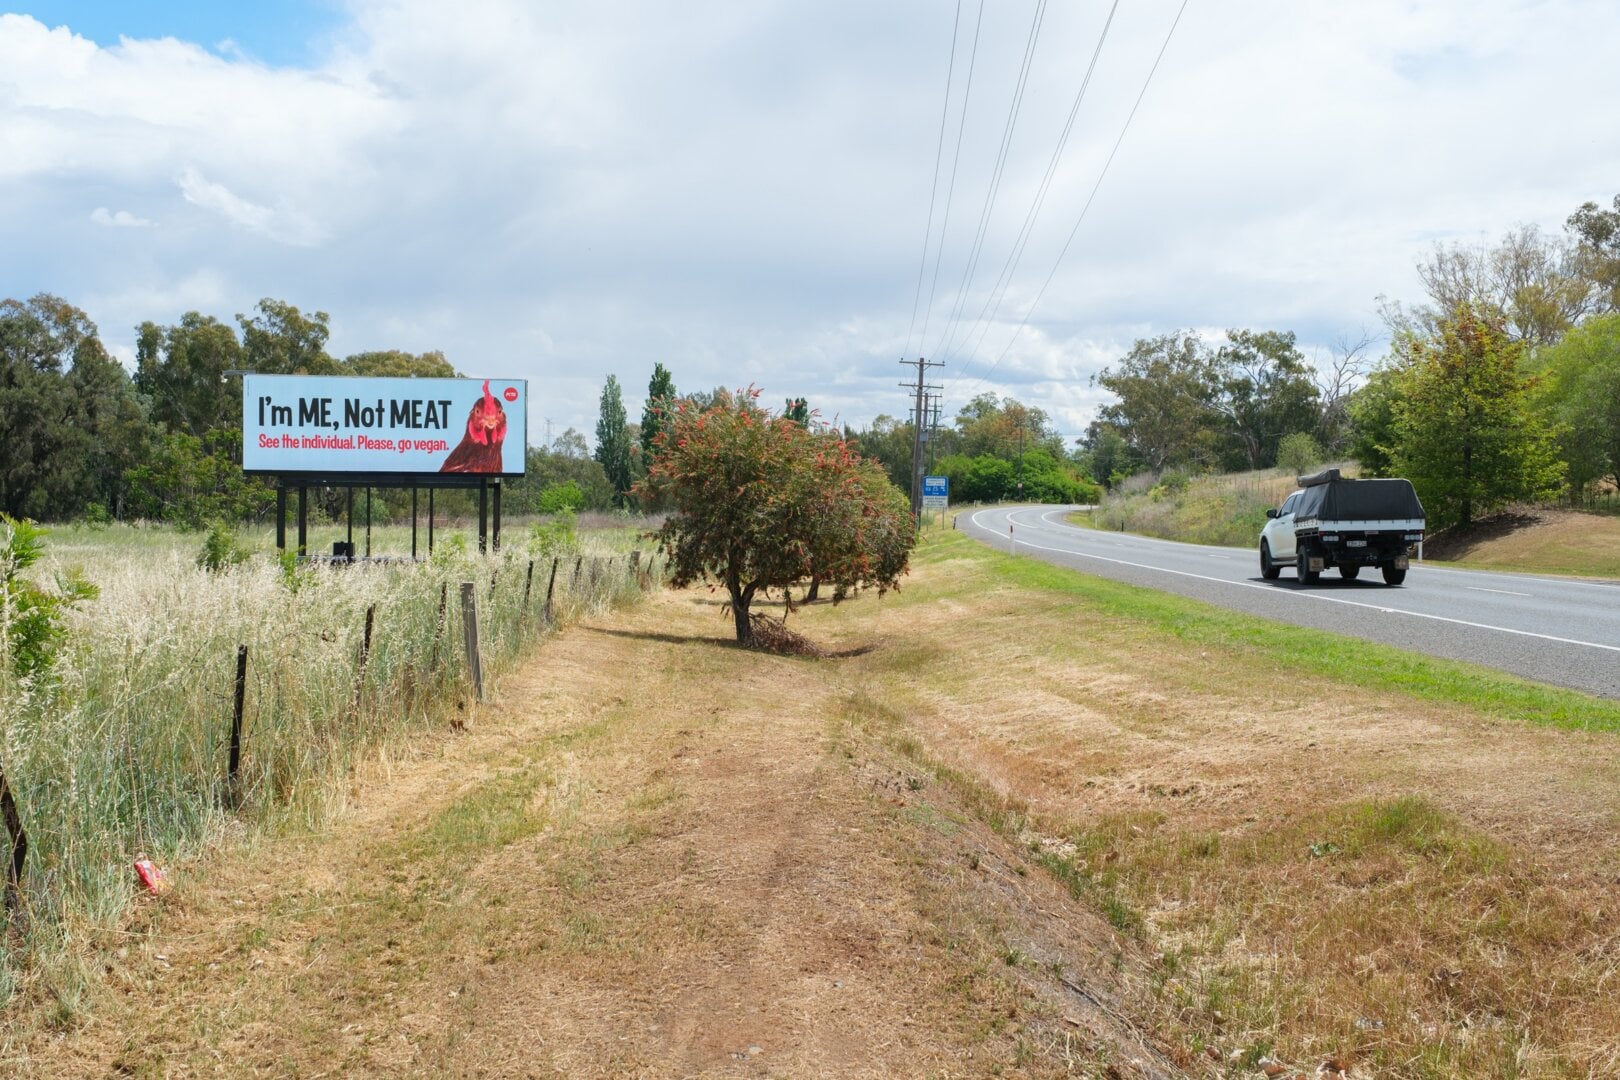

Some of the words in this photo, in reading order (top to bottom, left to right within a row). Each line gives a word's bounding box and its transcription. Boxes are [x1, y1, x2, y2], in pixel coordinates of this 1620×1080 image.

[258, 396, 292, 427] I'm
[299, 397, 339, 431] ME,
[344, 398, 385, 428] Not
[390, 399, 452, 429] MEAT
[258, 433, 280, 449] See
[281, 434, 300, 449] the
[301, 435, 356, 450] individual.
[357, 436, 396, 451] Please,
[397, 439, 412, 452] go
[413, 439, 449, 453] vegan.
